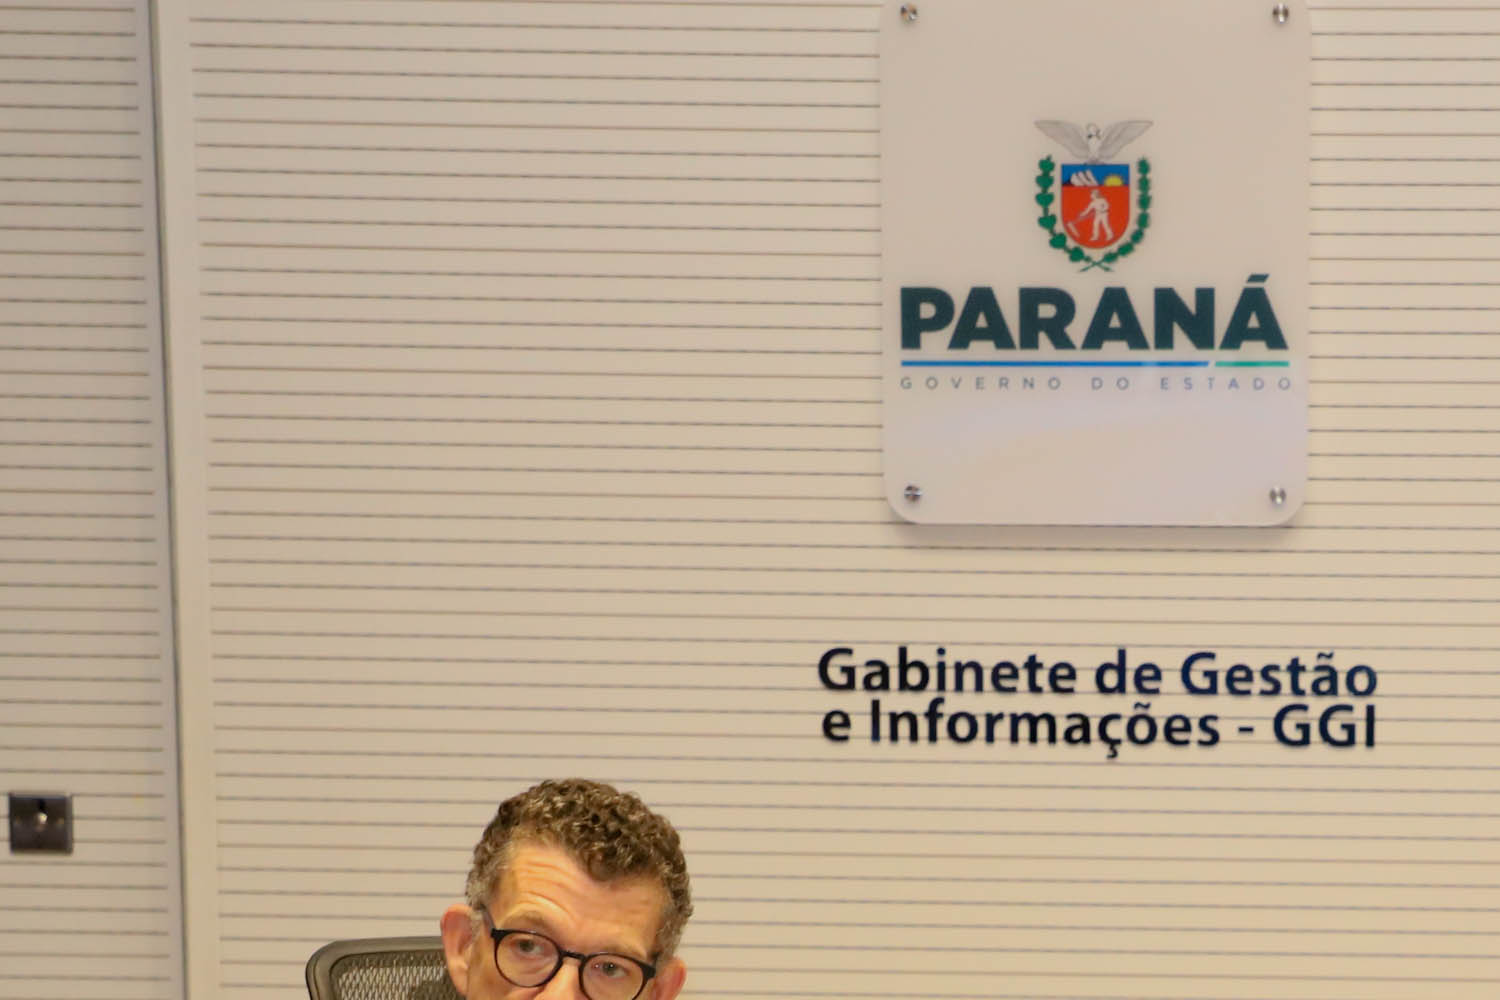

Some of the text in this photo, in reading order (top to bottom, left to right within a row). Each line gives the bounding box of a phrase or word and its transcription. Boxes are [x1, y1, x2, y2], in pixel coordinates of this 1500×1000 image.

[900, 274, 1289, 351] PARANÁ
[900, 376, 1291, 391] GOVERNO DO ESTADO
[817, 646, 1378, 698] Gabinete de Gestão
[821, 708, 852, 742] e
[871, 698, 1220, 758] Informações
[1272, 704, 1377, 747] GGI
